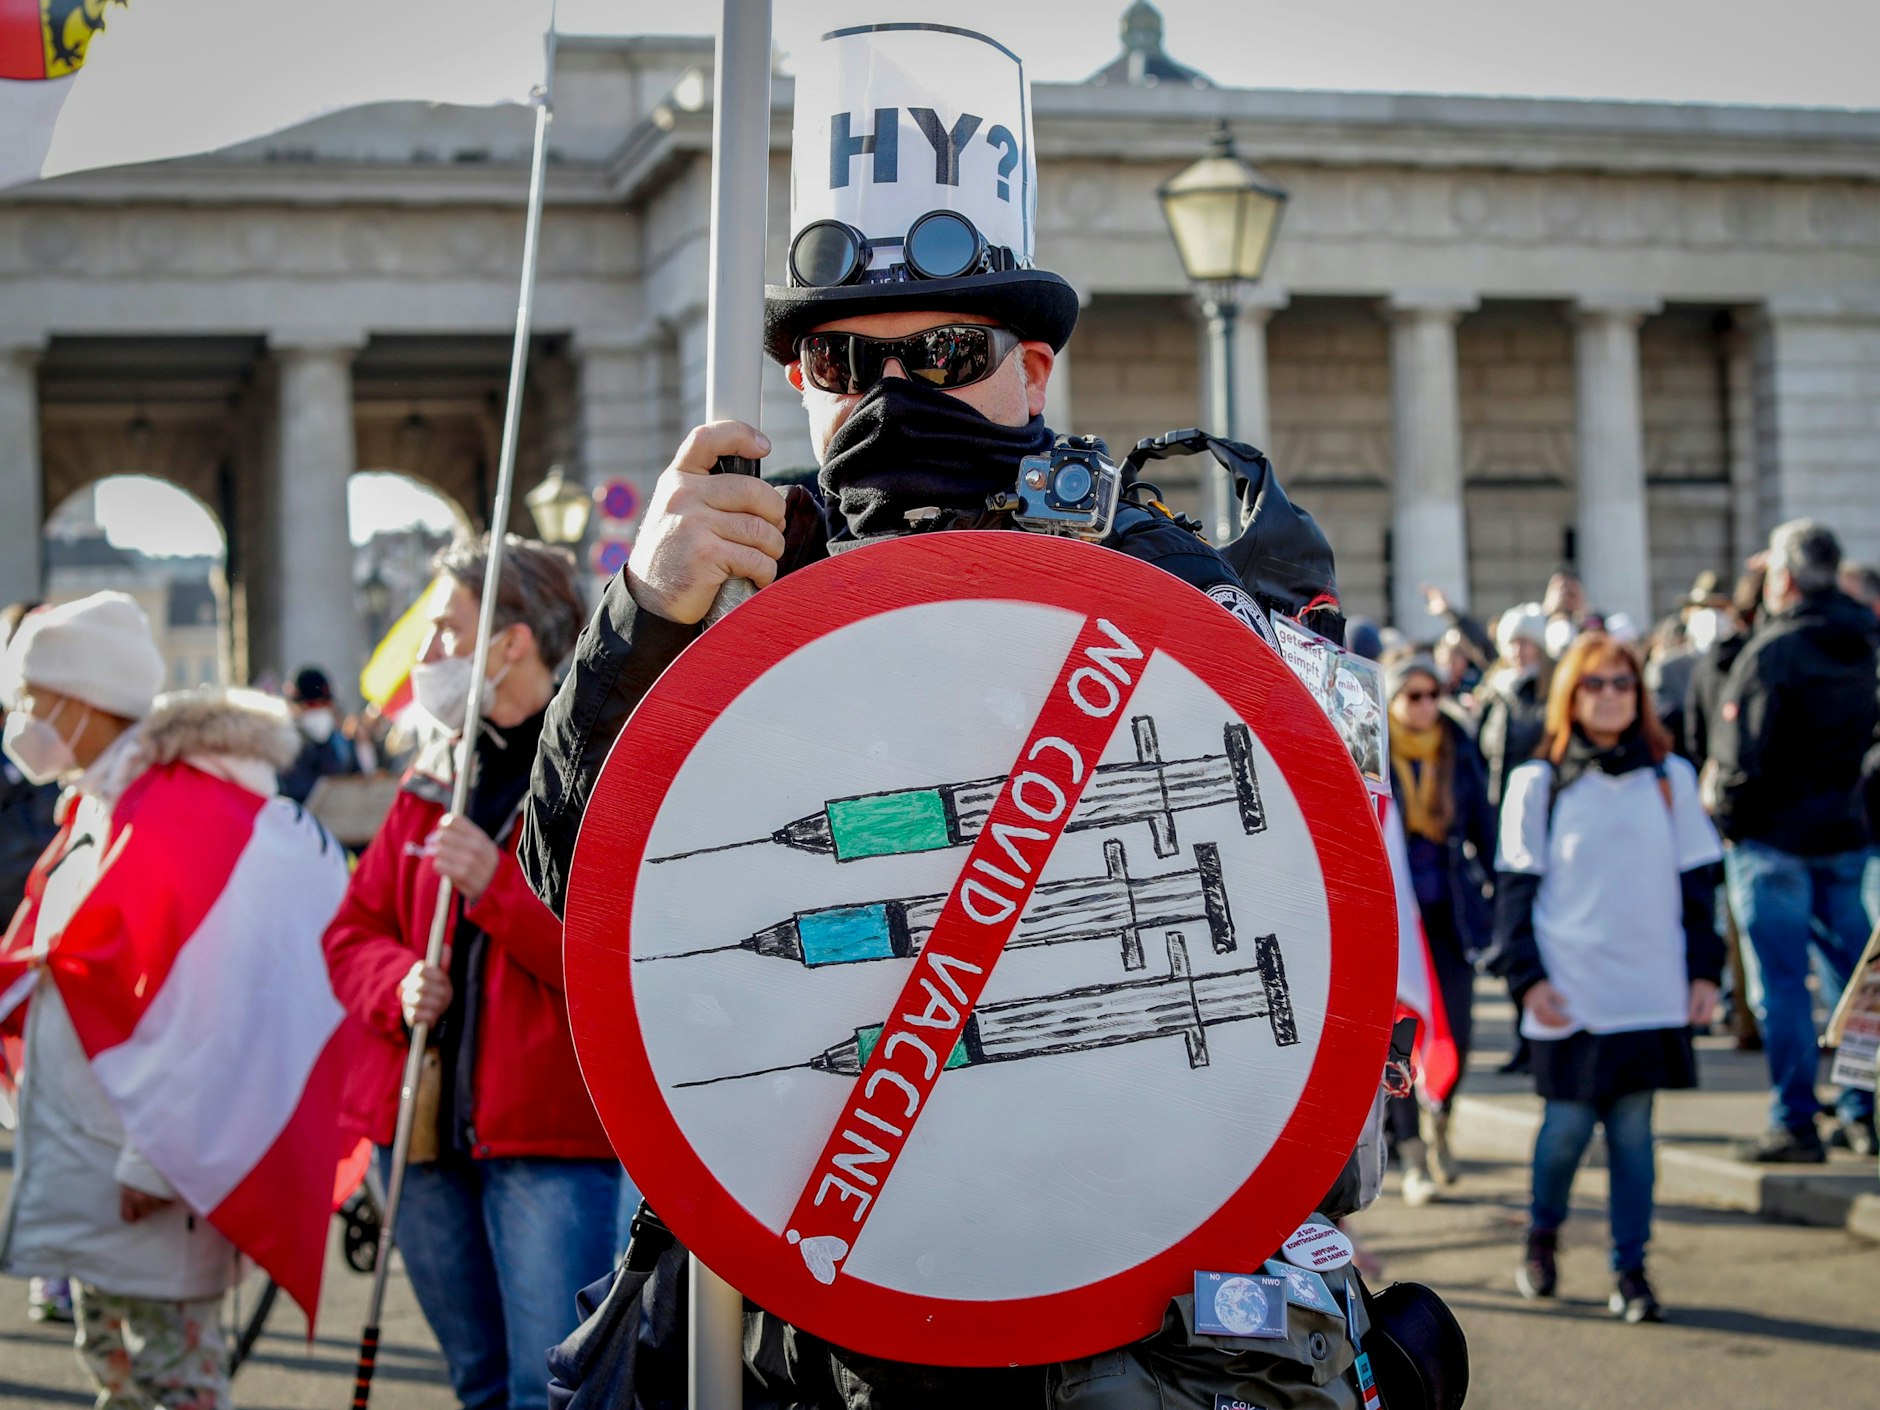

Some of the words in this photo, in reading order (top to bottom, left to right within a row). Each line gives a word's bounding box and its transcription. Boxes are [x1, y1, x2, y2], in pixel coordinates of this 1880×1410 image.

[829, 107, 1019, 203] HY?
[1067, 618, 1144, 718] NO
[961, 736, 1085, 925] COVID
[814, 952, 983, 1222] VACCINE
[1209, 1273, 1221, 1281] NO
[1261, 1278, 1281, 1287] NWO
